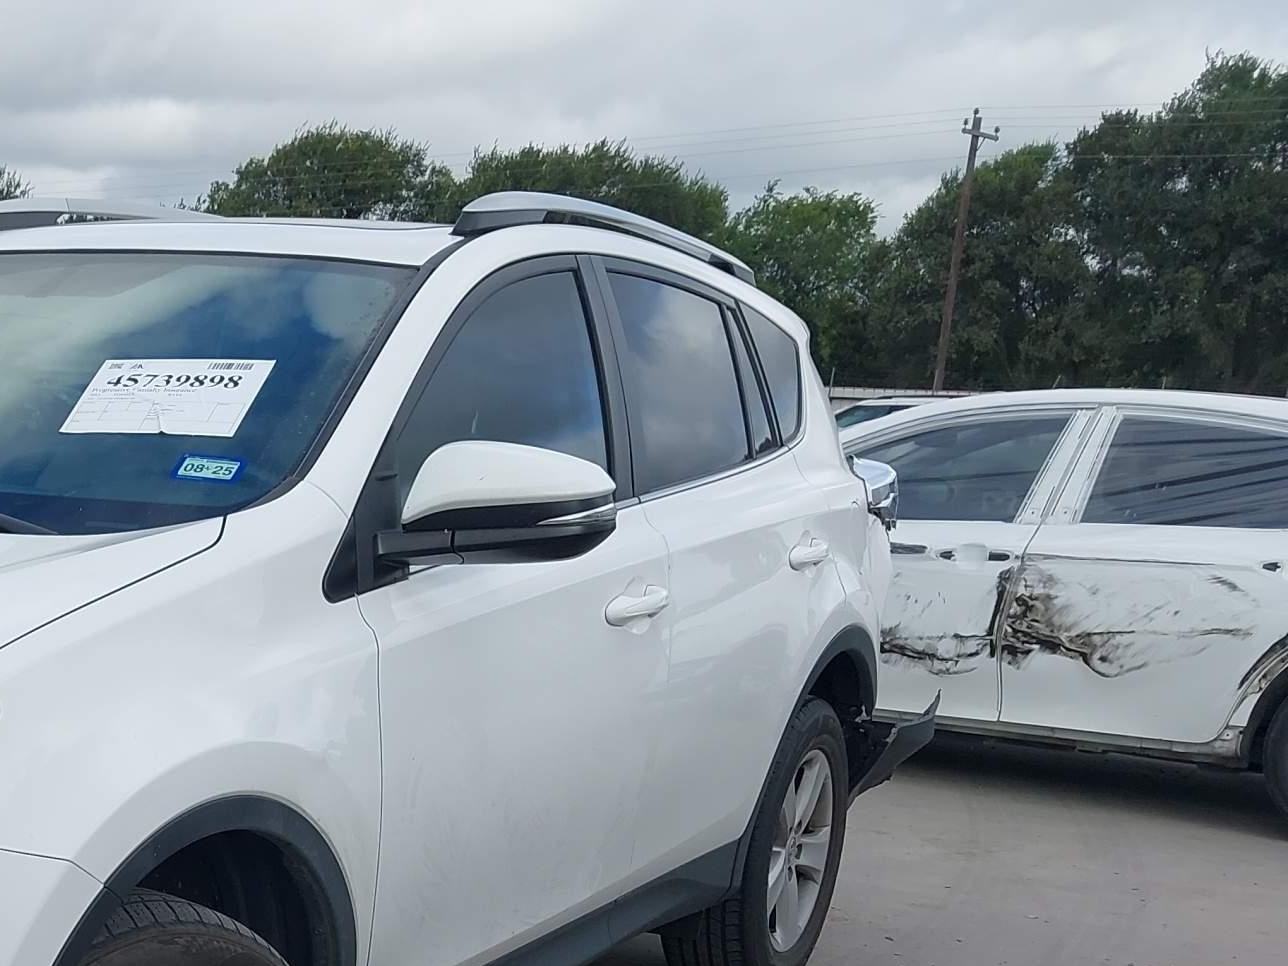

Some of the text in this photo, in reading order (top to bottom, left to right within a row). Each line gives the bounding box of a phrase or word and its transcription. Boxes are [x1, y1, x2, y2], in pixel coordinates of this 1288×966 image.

[106, 373, 244, 389] 45739898
[183, 462, 235, 476] 08 25
